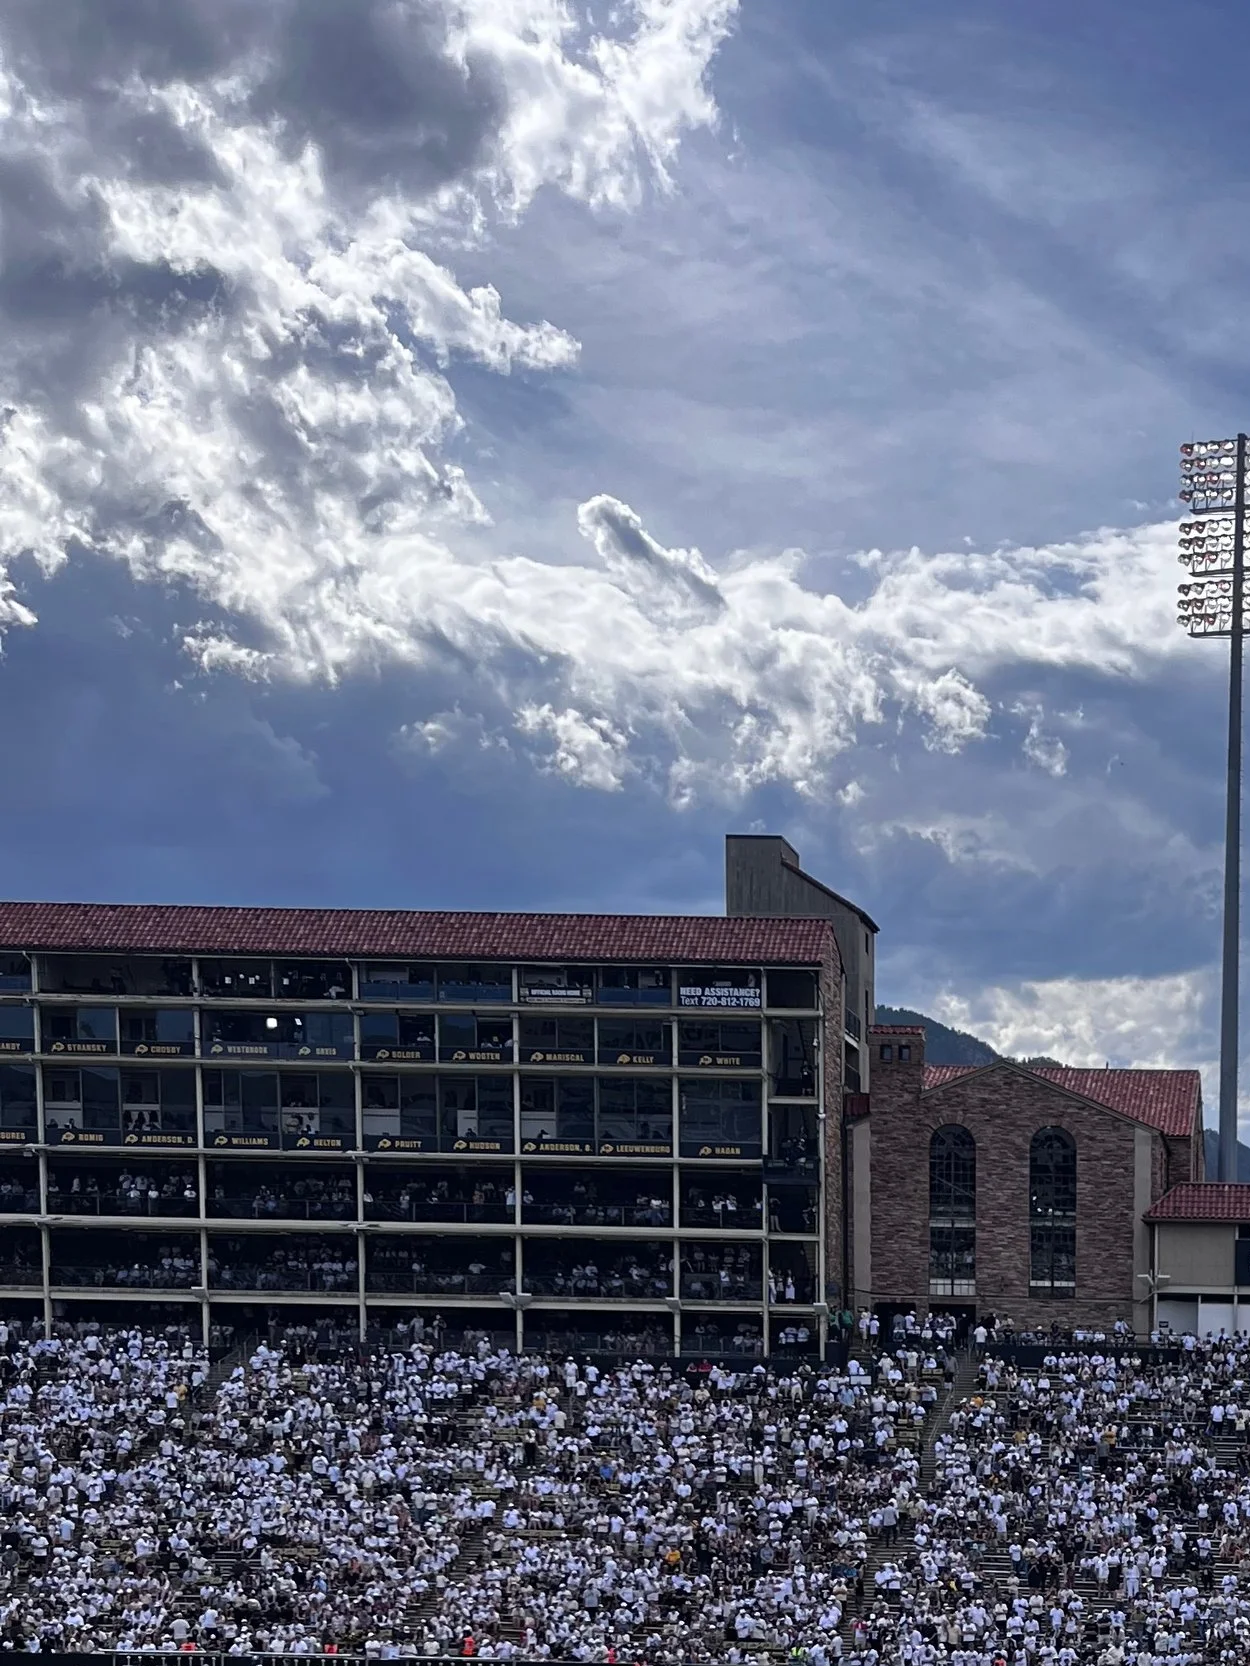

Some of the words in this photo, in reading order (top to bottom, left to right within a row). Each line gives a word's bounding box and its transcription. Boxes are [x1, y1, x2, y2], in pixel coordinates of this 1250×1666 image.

[680, 987, 701, 996] NEED
[704, 988, 760, 998] ASSISTANCE?
[681, 997, 699, 1006] Text
[701, 997, 760, 1007] 720-812-1769
[632, 1055, 654, 1064] KELLY
[232, 1137, 268, 1146] WILLIAMS
